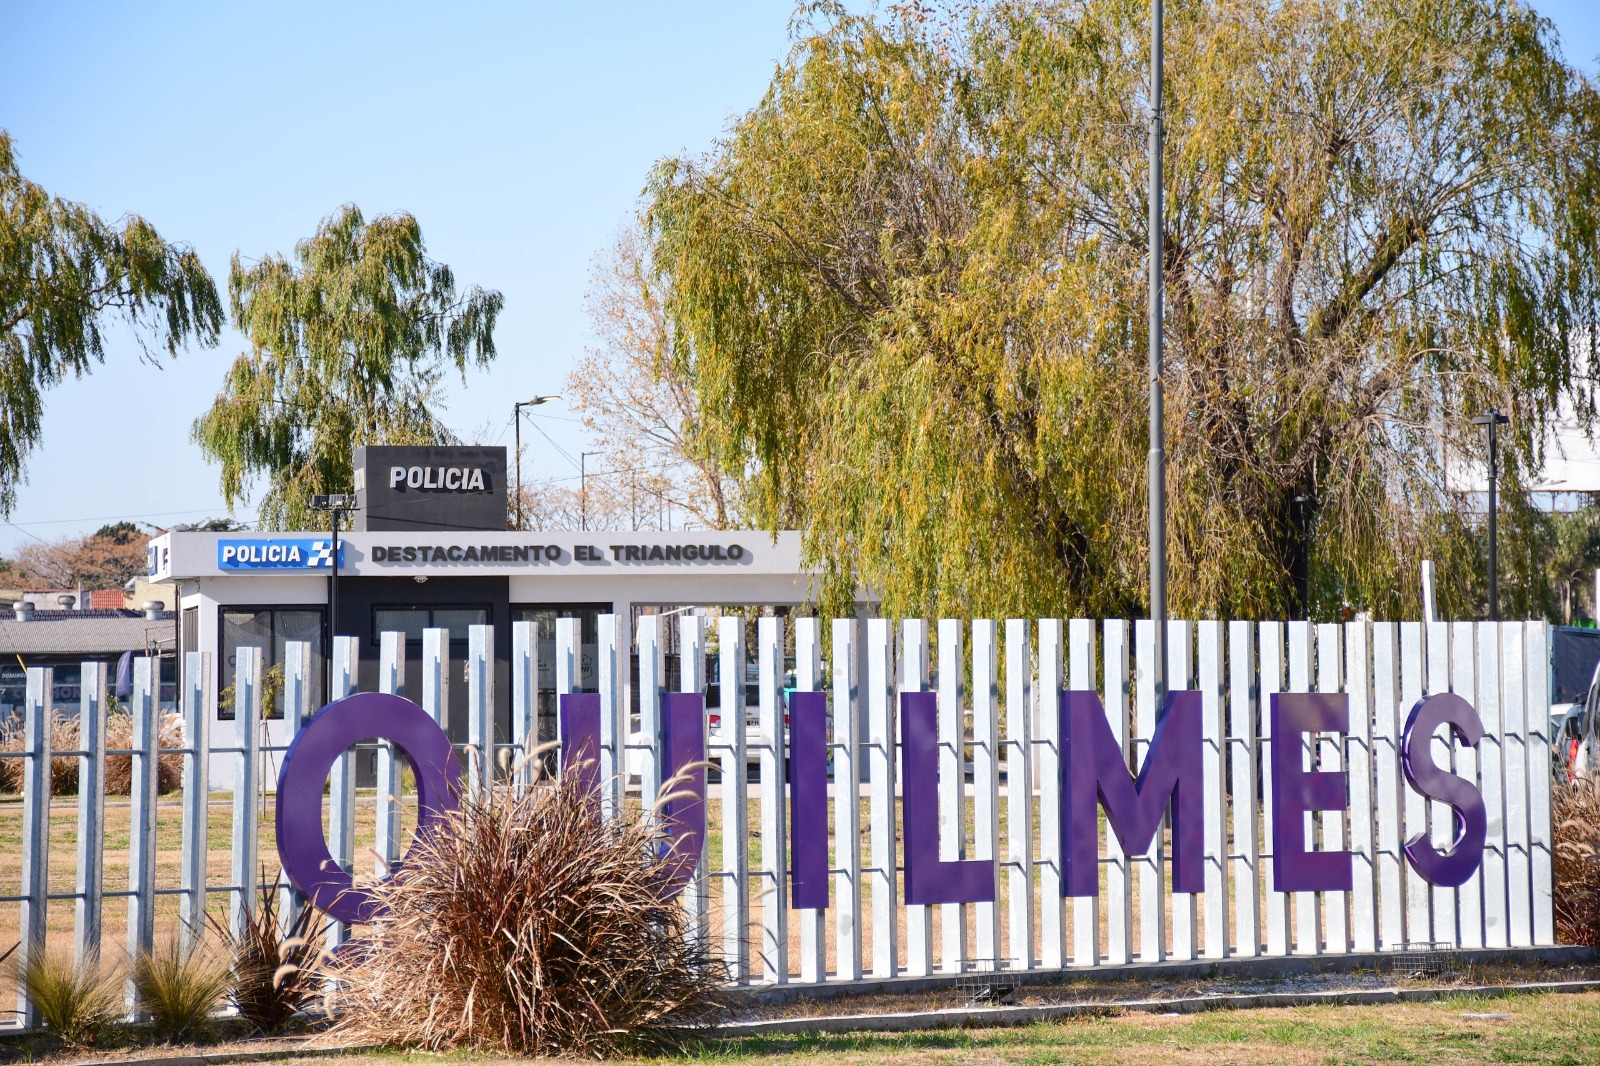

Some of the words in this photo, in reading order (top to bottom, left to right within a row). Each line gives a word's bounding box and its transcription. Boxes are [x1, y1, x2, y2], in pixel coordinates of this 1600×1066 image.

[390, 466, 485, 490] POLICIA
[223, 545, 300, 562] POLICIA
[372, 545, 561, 562] DESTACAMENTO
[574, 545, 602, 561] EL
[610, 544, 743, 561] TRIANGULO
